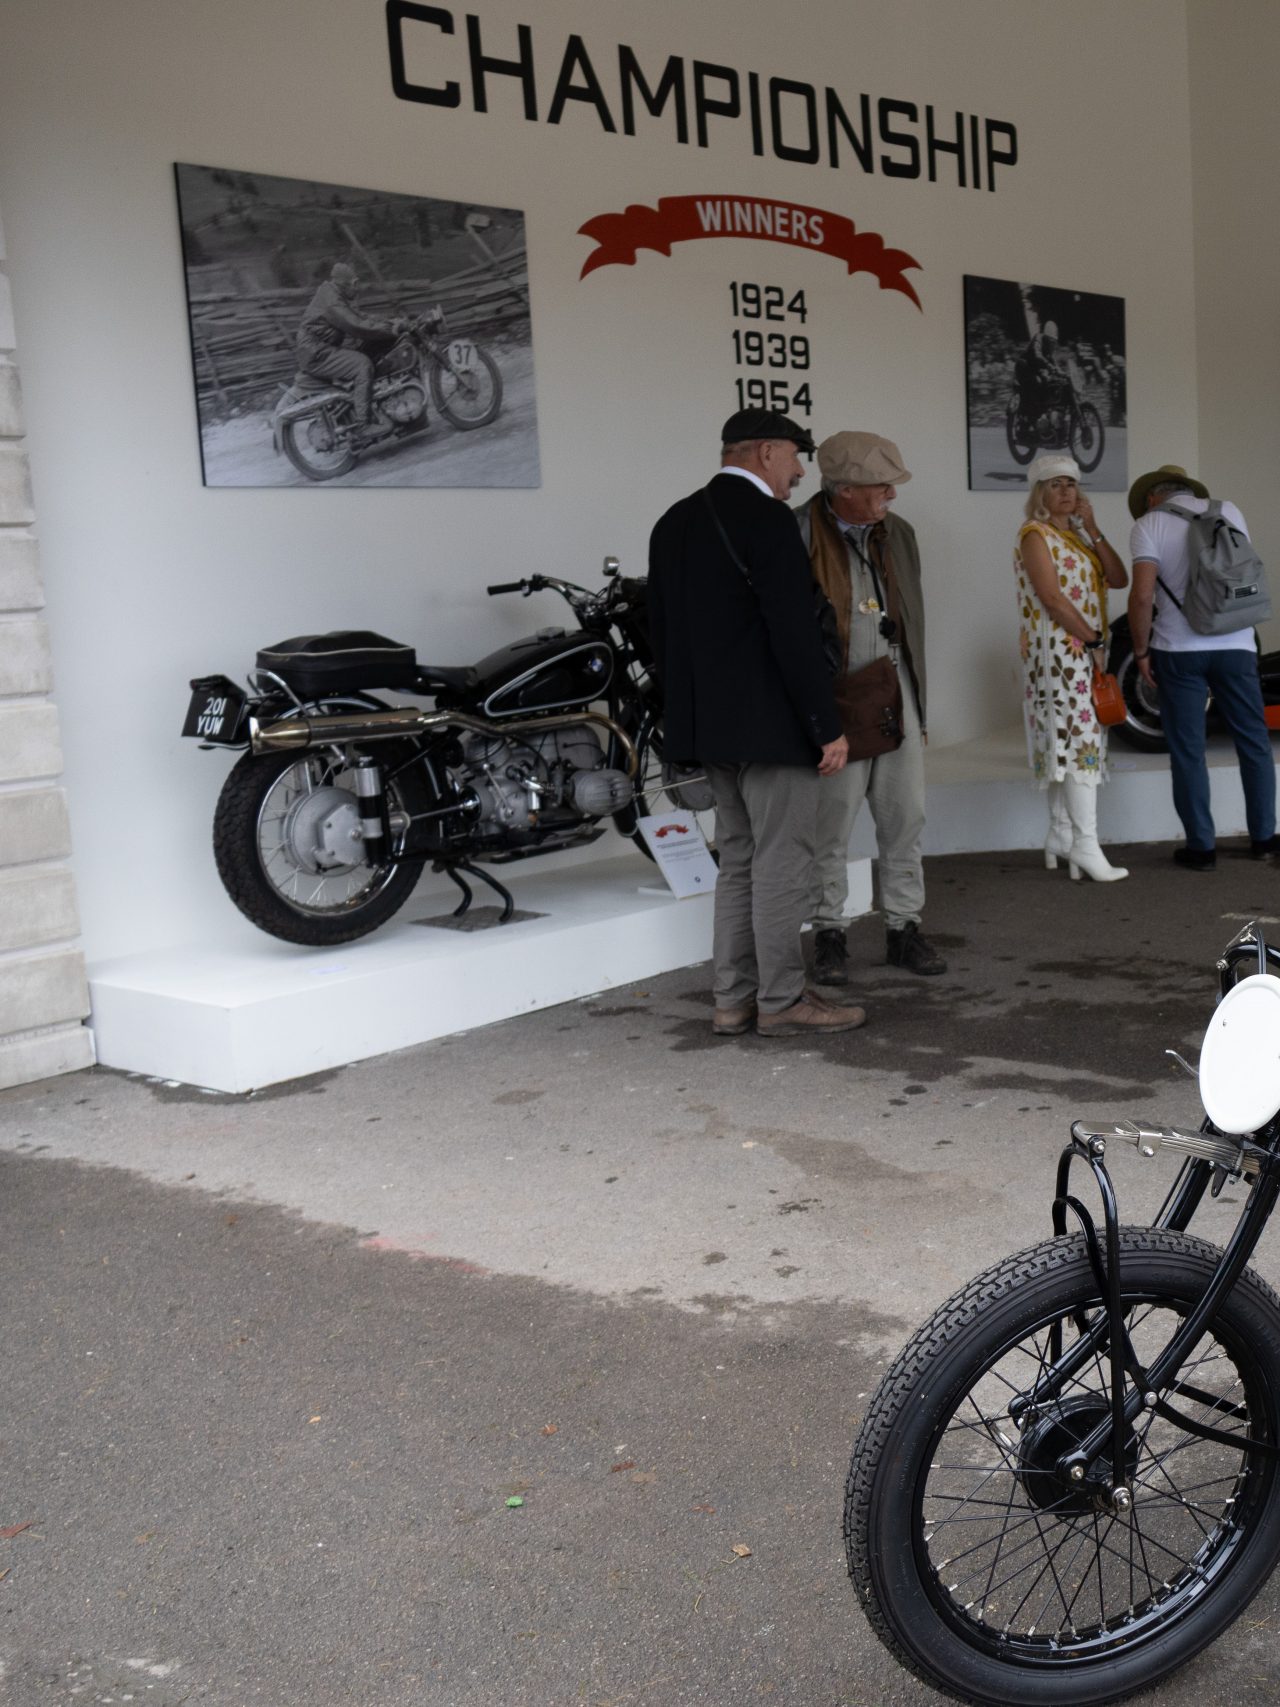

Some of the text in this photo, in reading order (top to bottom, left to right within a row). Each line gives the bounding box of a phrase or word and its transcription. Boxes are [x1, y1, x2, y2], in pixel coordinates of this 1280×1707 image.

[386, 0, 1018, 192] CHAMPIONSHIP
[695, 200, 825, 245] WINNERS
[729, 281, 808, 324] 1924
[453, 344, 472, 366] 37
[732, 329, 810, 370] 1939
[735, 378, 812, 416] 1954
